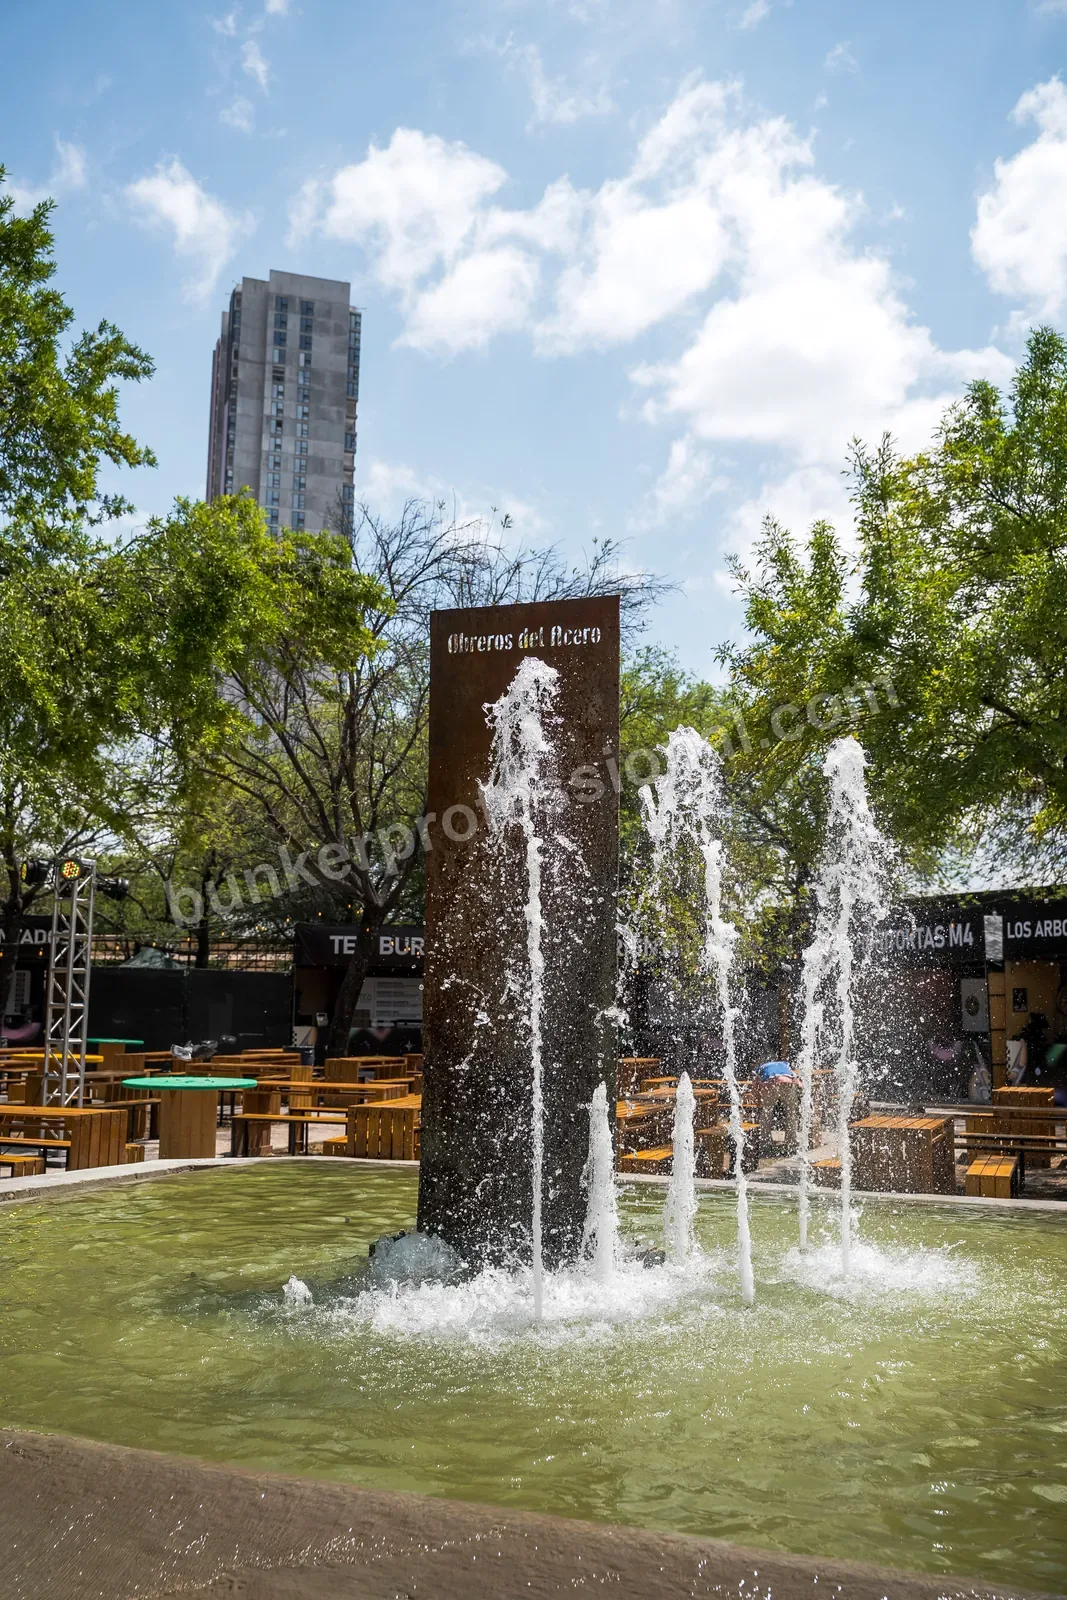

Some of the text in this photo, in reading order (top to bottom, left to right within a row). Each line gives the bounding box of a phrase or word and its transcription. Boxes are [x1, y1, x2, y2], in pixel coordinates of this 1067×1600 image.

[447, 625, 601, 654] Obreros del Acero
[950, 922, 973, 947] M4
[1007, 921, 1031, 938] LOS
